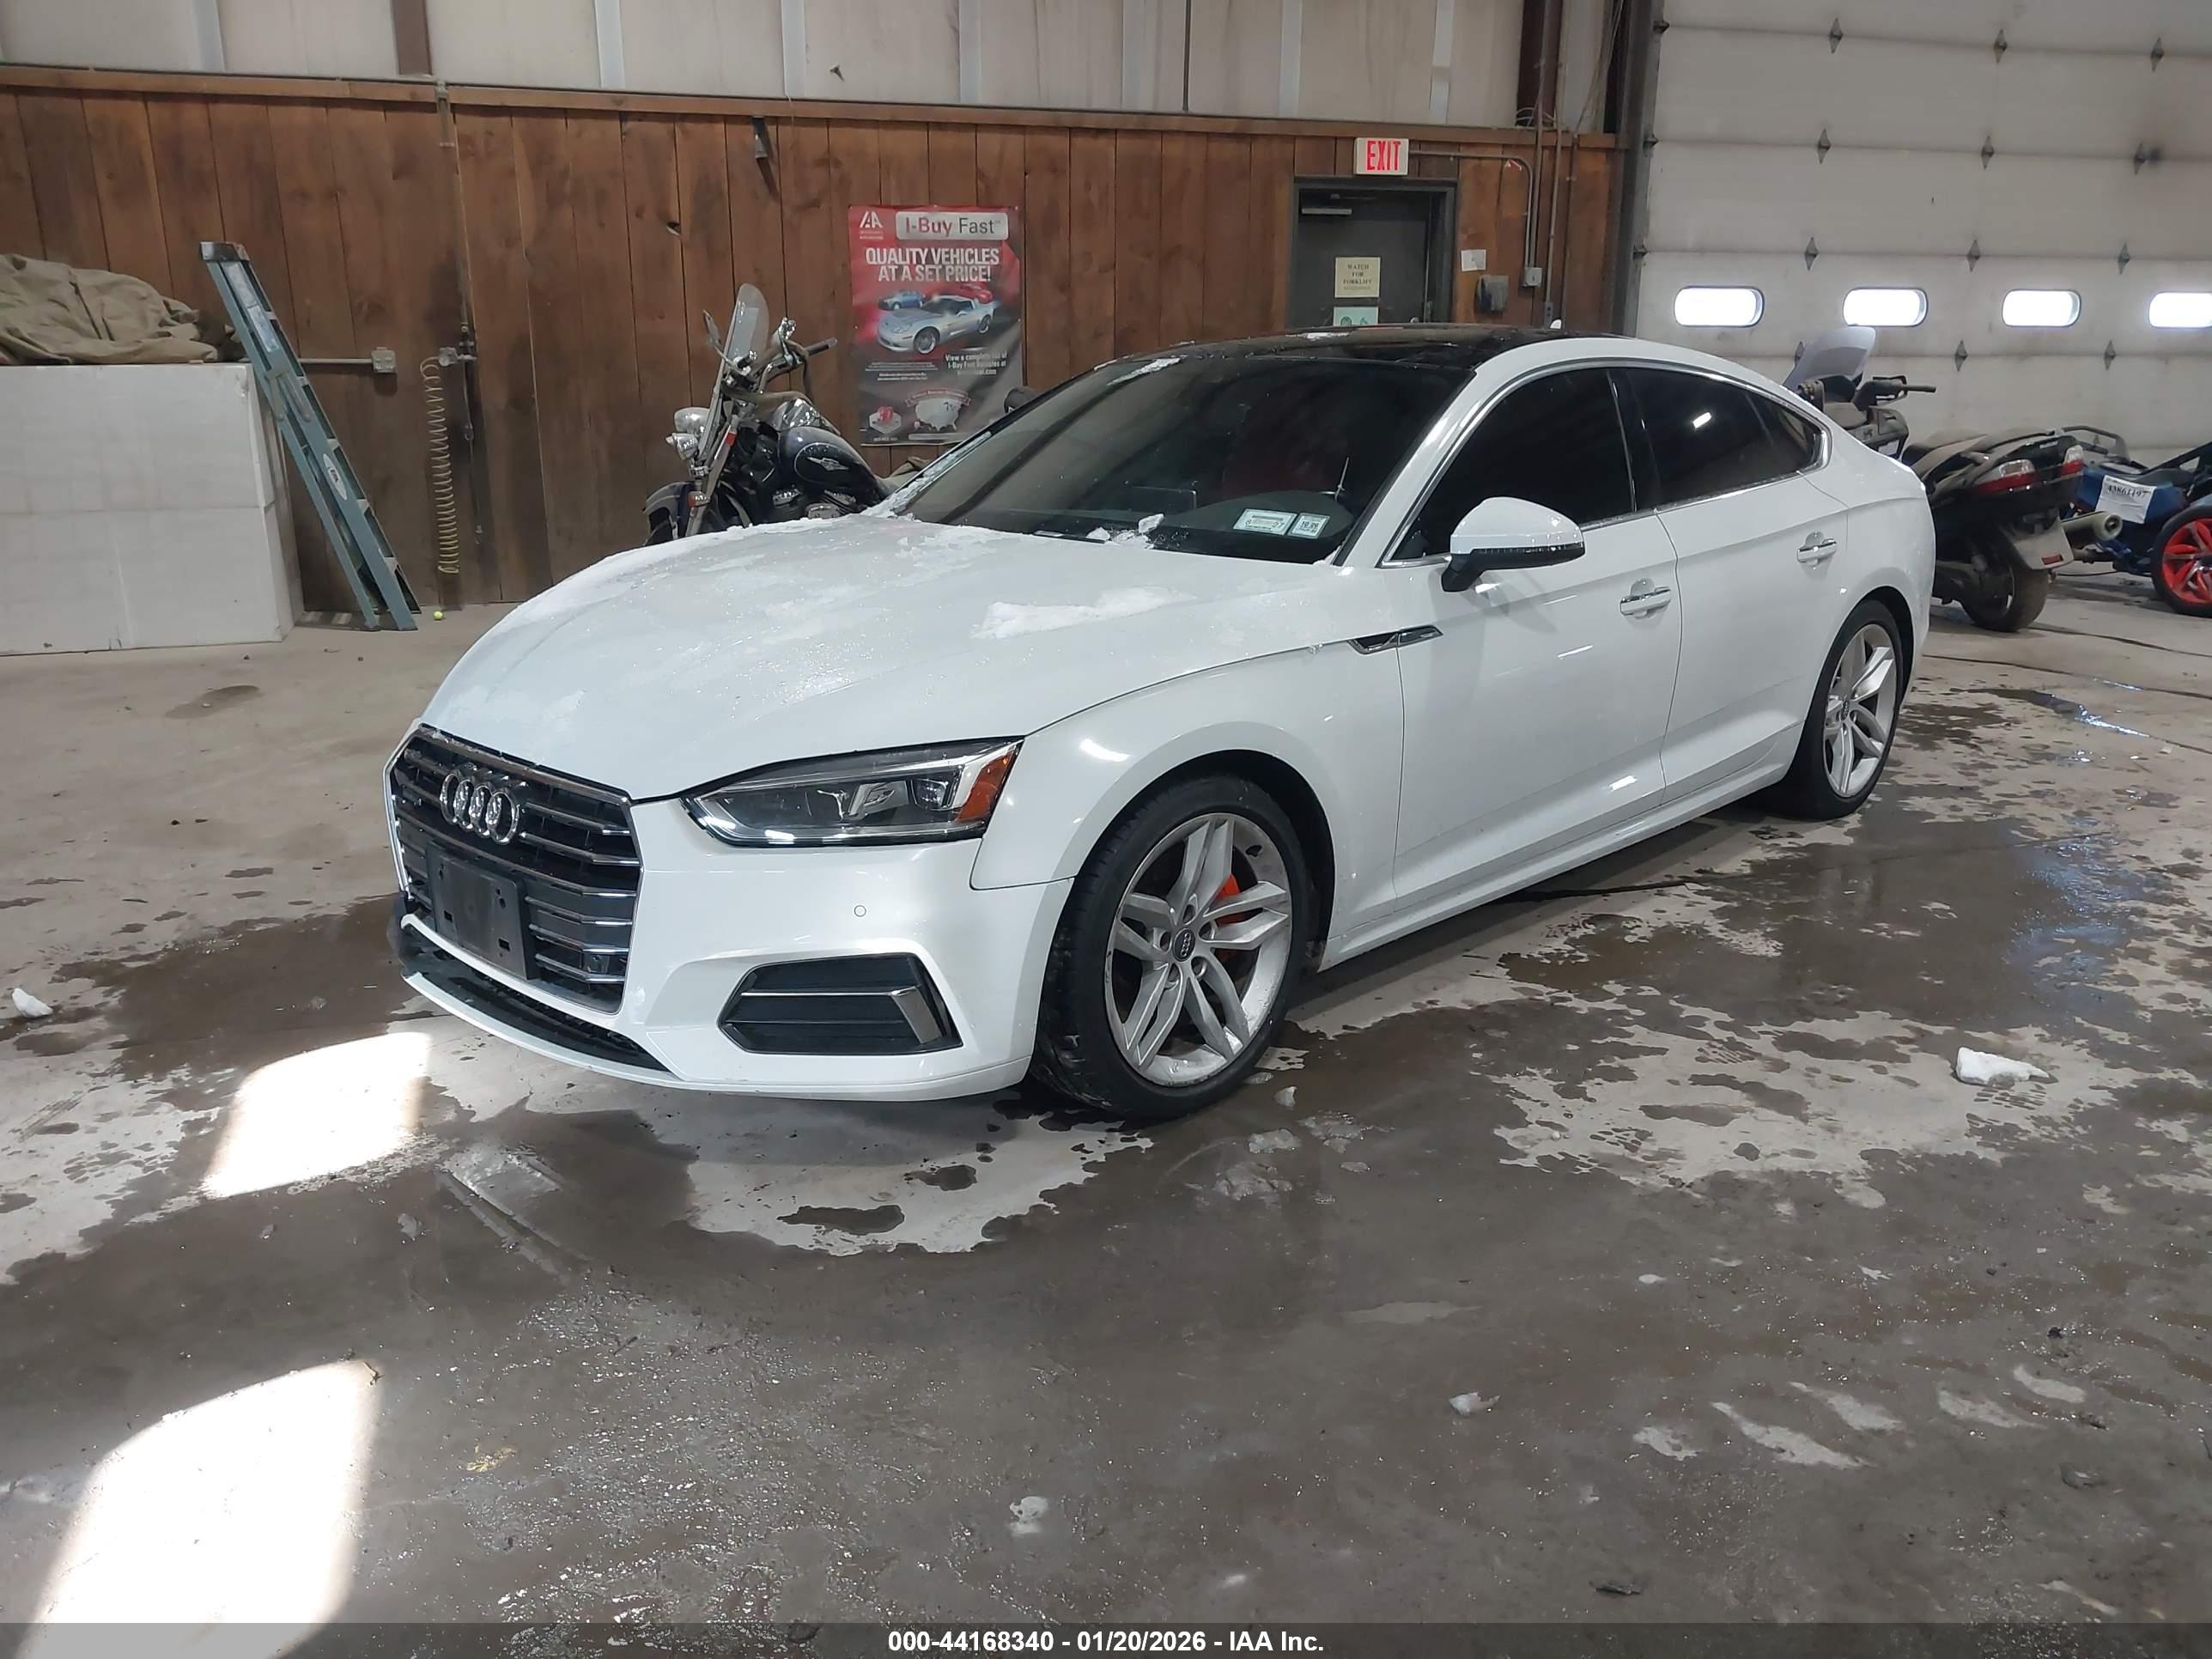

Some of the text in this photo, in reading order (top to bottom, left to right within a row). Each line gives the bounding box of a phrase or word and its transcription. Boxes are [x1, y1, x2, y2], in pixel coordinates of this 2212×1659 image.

[1366, 140, 1401, 171] EXIT
[905, 217, 995, 236] I-Buy Fast
[866, 247, 1000, 265] QUALITY VEHICLES
[878, 264, 991, 283] AT A SET PRICE!
